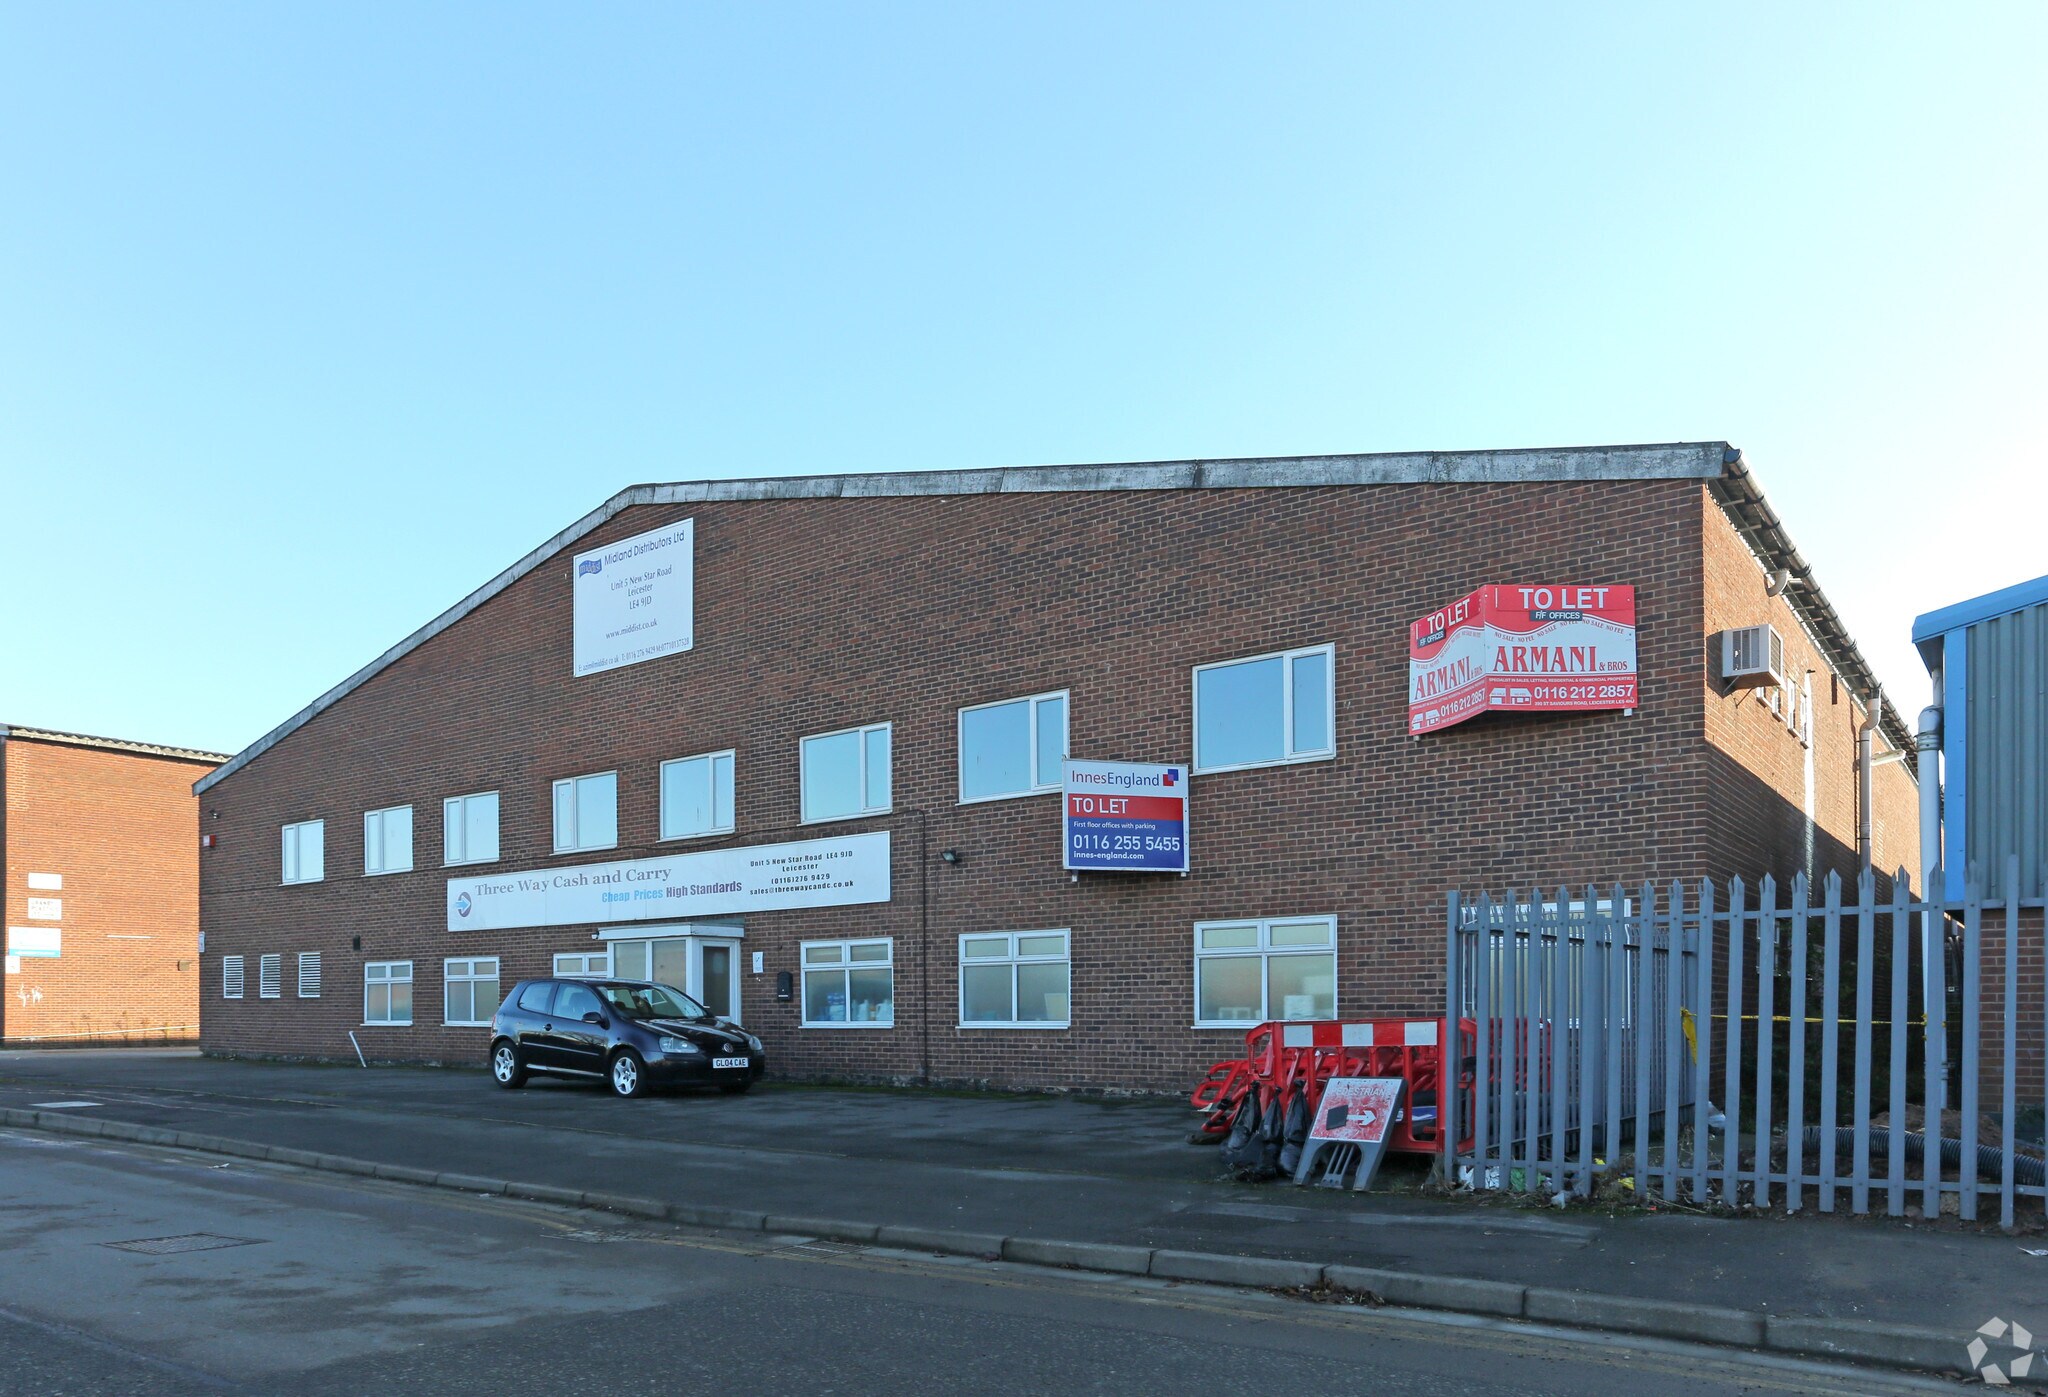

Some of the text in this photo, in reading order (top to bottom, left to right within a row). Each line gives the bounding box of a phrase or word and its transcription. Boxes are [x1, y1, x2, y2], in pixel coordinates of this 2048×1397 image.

[604, 530, 685, 565] Midland Distributors Ltd
[611, 564, 672, 591] Unit 5 New Star Road
[628, 583, 653, 597] Leicester
[1518, 588, 1609, 609] TO LET
[630, 595, 652, 610] LE4 9JD
[1427, 598, 1470, 634] TO LET
[1549, 611, 1580, 619] OFFICES
[1545, 625, 1557, 635] SALE
[1591, 621, 1604, 629] SALE
[1427, 630, 1444, 643] OFFICES
[1493, 646, 1628, 672] ARMANI & BROS
[1415, 656, 1470, 700] ARMANI
[1534, 685, 1634, 699] 0116 212 2857
[1441, 701, 1459, 717] 0116
[1460, 695, 1471, 711] 212
[1471, 687, 1486, 705] 2857
[1072, 770, 1160, 788] InnesEngland
[1072, 797, 1129, 814] TO LET
[1073, 834, 1180, 851] 0116 255 5455
[1073, 851, 1144, 860] innes-england.com
[782, 863, 818, 872] Leicester
[475, 868, 672, 896] Three Way Cash and Carry
[811, 873, 830, 881] 9429
[602, 881, 742, 903] Cheap Prices High Standards
